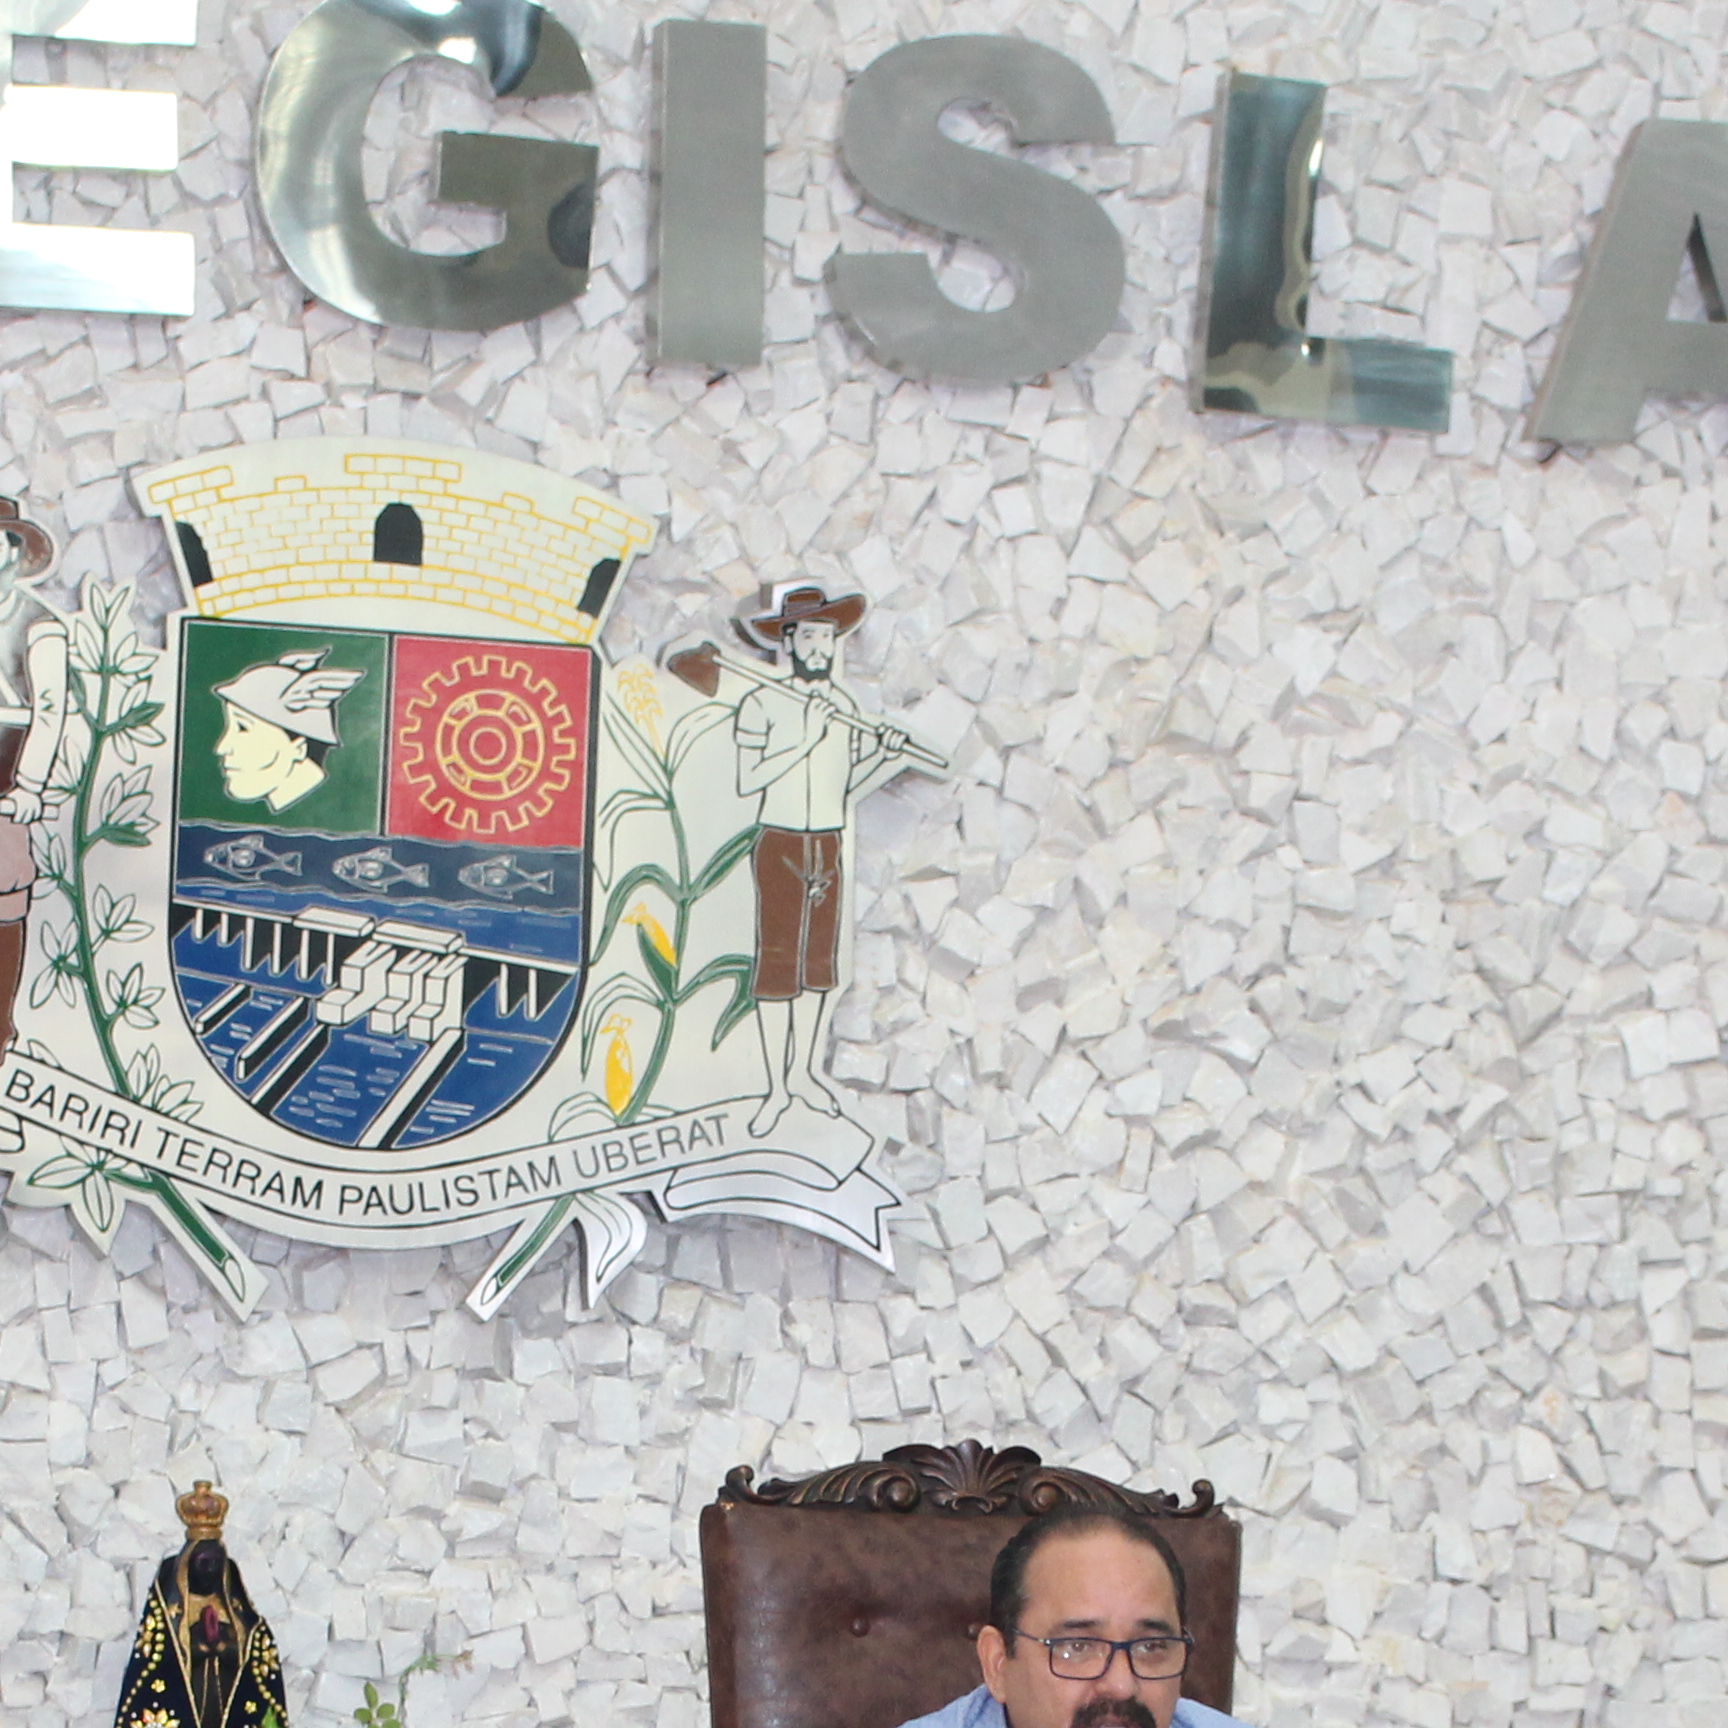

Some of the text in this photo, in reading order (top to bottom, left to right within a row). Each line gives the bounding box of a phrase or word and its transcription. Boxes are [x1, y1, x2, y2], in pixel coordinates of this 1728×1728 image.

[5, 1068, 730, 1217] BARIRI TERRAM PAULISTAM UBERAT
